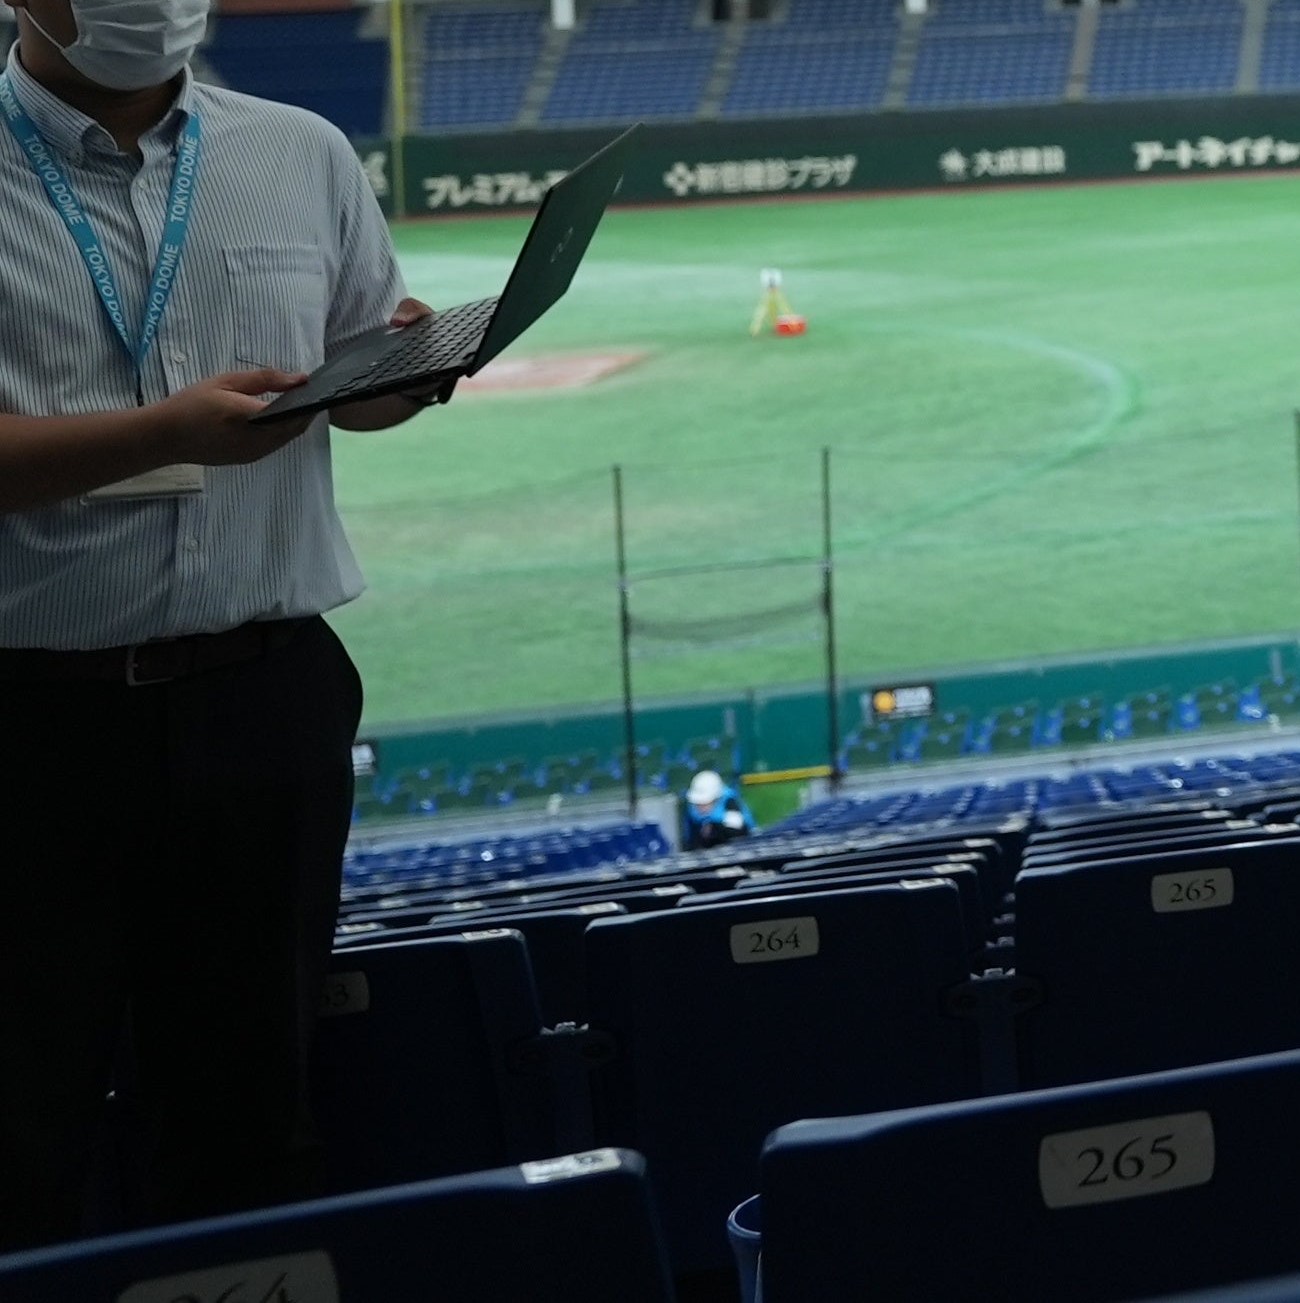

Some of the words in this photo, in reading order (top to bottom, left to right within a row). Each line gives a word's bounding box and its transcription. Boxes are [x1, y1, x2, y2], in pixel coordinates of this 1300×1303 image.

[23, 134, 60, 183] TOKYO
[50, 180, 84, 226] DOME
[180, 134, 199, 175] DOME
[169, 175, 192, 224] TOKYO
[84, 244, 115, 298] TOKYO
[141, 290, 165, 345] TOKYO
[155, 242, 179, 289] DOME
[1168, 878, 1217, 904] 265
[749, 925, 802, 954] 264
[1077, 1134, 1178, 1187] 265
